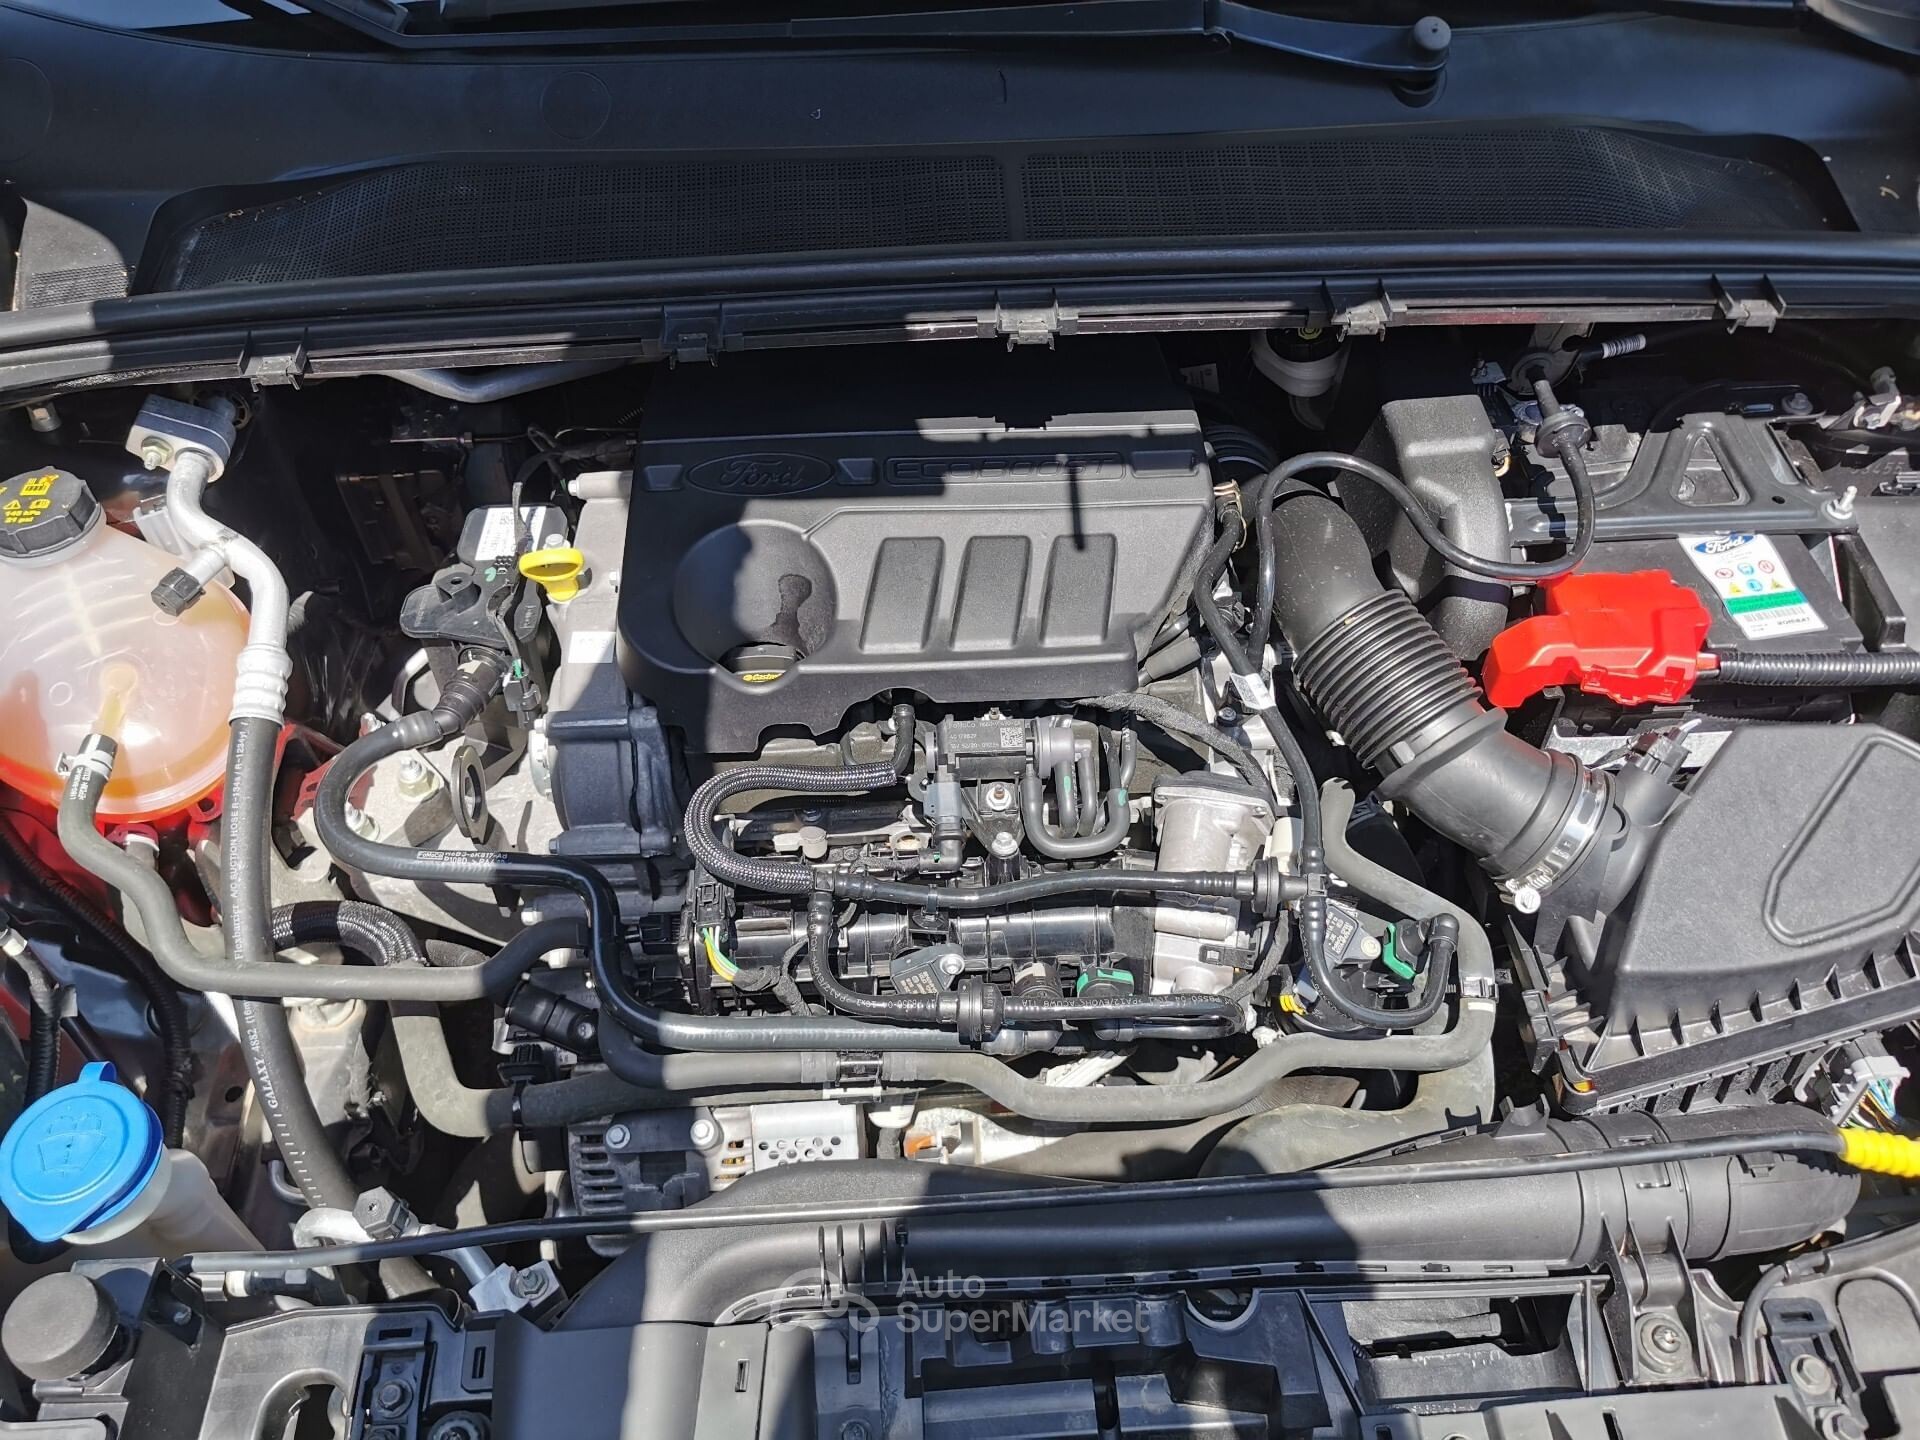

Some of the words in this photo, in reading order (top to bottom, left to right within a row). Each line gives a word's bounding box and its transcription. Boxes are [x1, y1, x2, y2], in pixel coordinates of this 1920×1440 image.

[716, 459, 803, 488] Ford
[1704, 535, 1746, 554] Ford
[230, 810, 239, 837] HOSE
[229, 838, 240, 880] SUCTION
[246, 1027, 260, 1053] 4882
[253, 1057, 279, 1109] GALAXY
